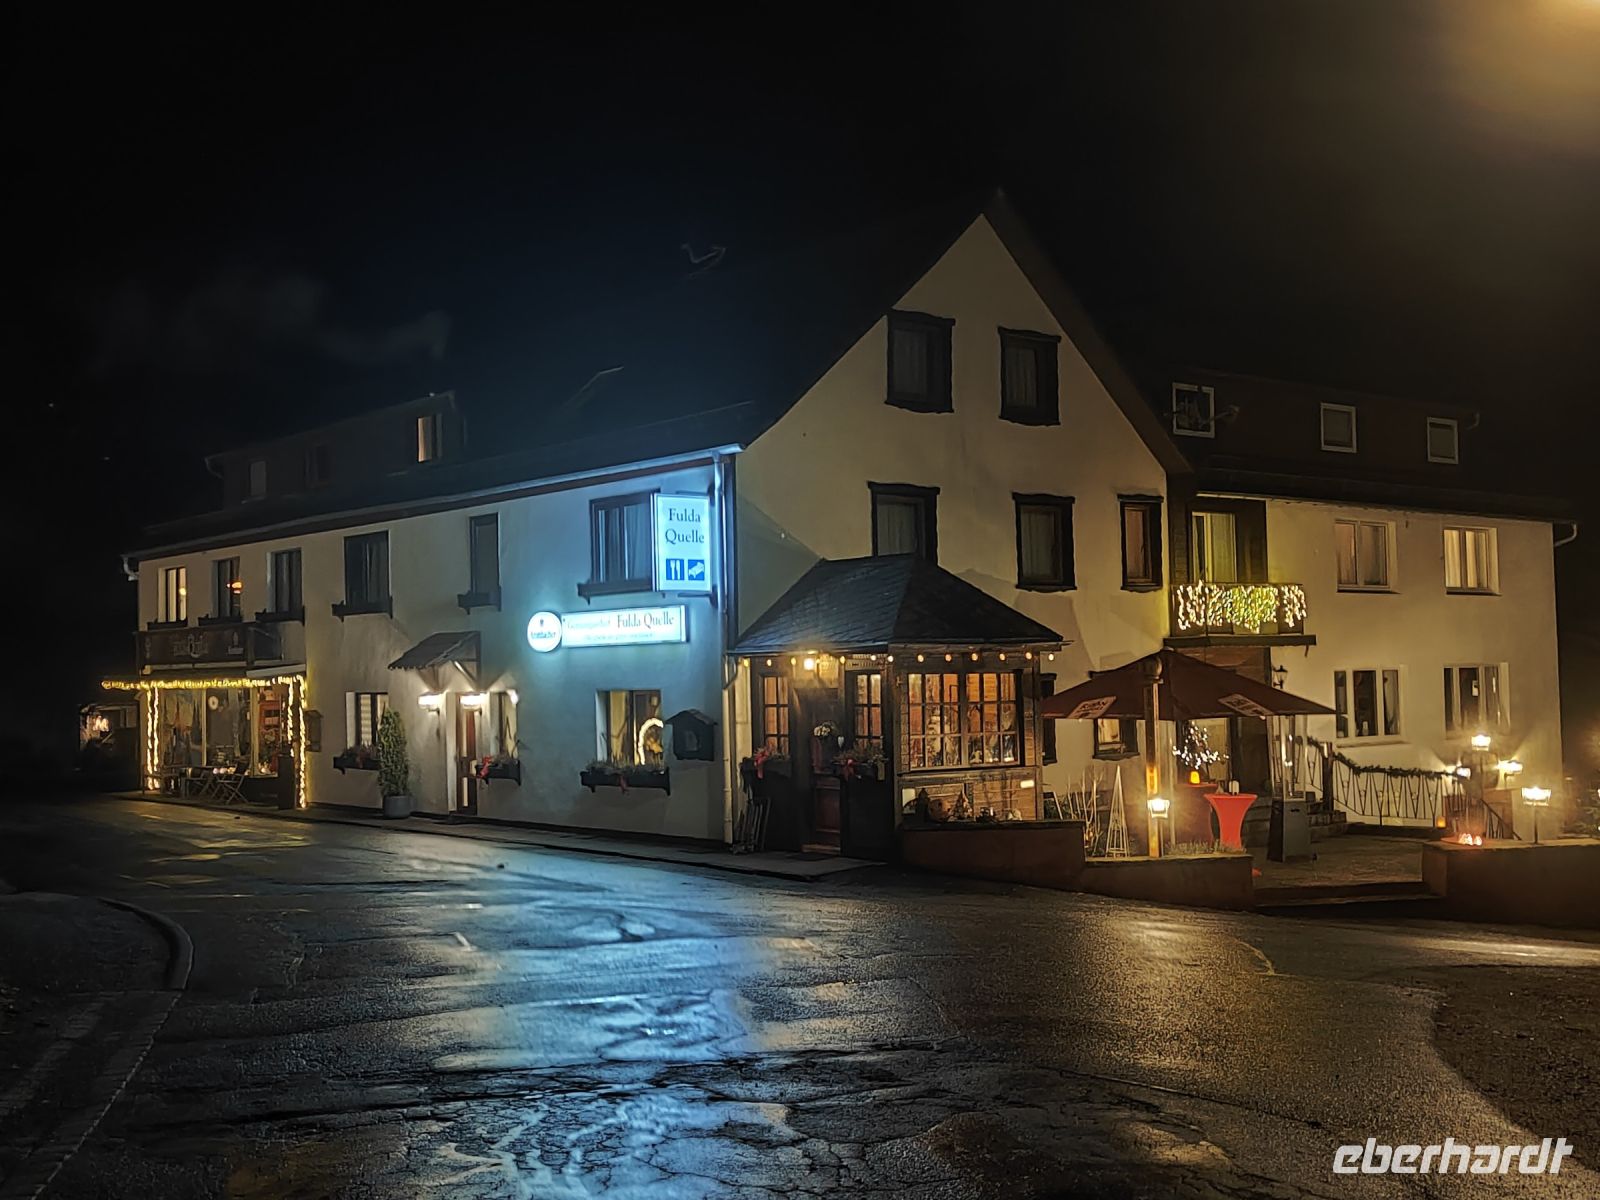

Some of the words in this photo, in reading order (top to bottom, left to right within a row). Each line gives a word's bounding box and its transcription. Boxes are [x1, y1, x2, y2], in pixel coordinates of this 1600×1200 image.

[669, 508, 700, 522] Fulda
[665, 529, 704, 545] Quelle
[617, 613, 640, 629] Fulda
[643, 611, 674, 629] Quelle
